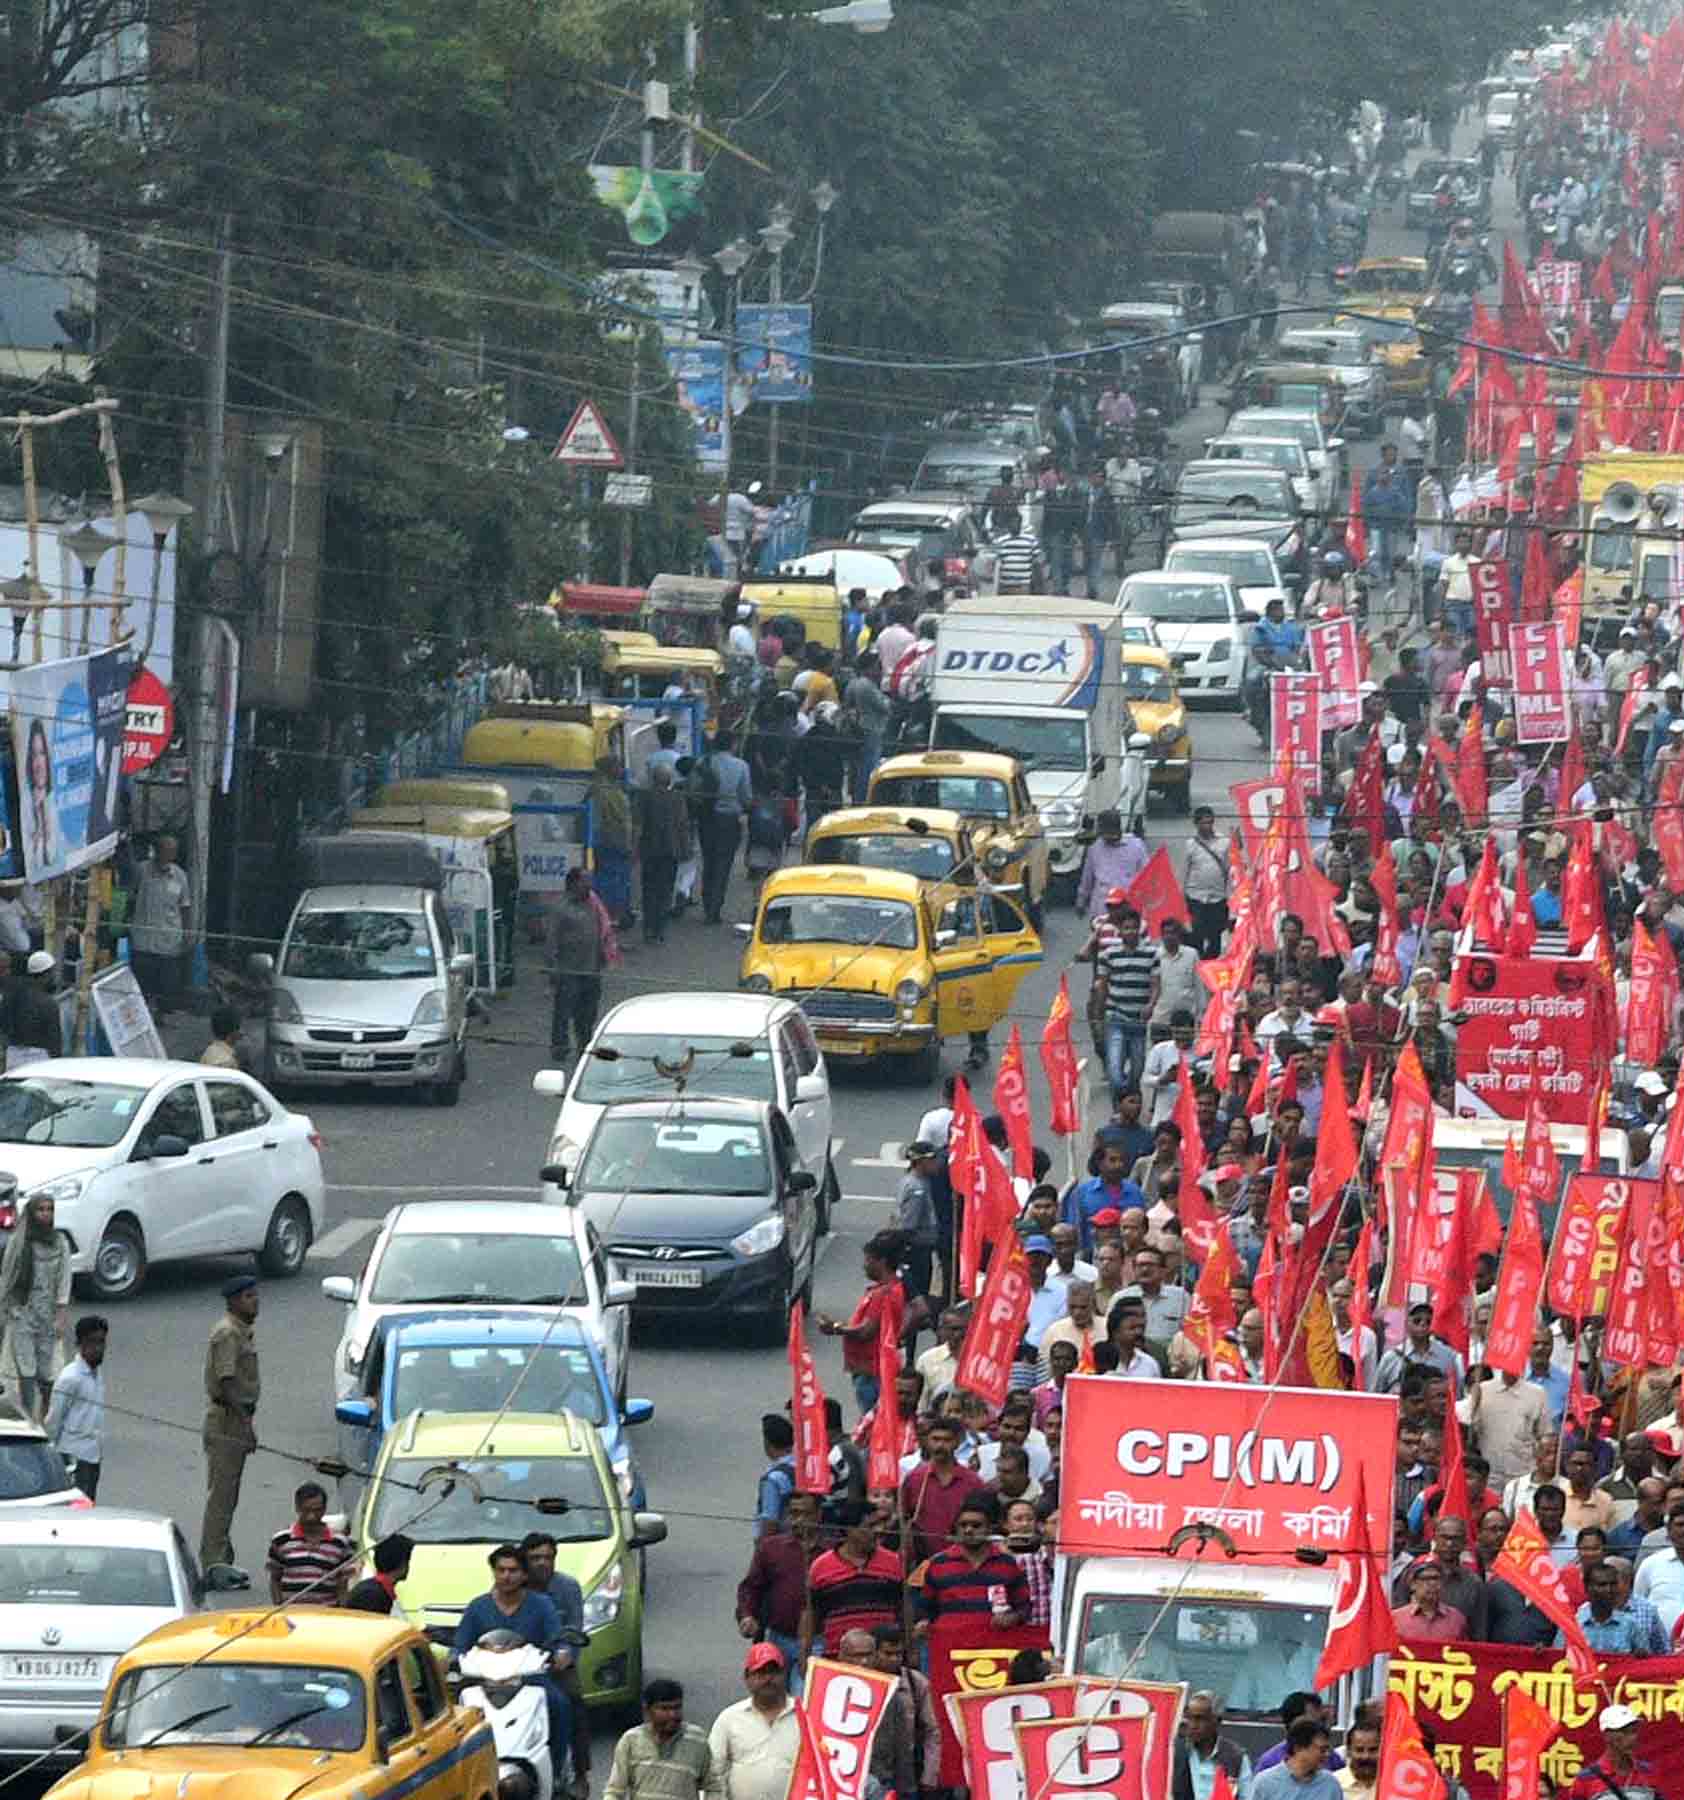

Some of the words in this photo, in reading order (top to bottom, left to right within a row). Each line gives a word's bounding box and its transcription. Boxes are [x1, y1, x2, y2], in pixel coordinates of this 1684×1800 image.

[942, 646, 1044, 674] DTDC
[521, 853, 568, 880] POLICE
[1117, 1428, 1342, 1492] CPI(M)
[1078, 1490, 1168, 1532] নদীয়া
